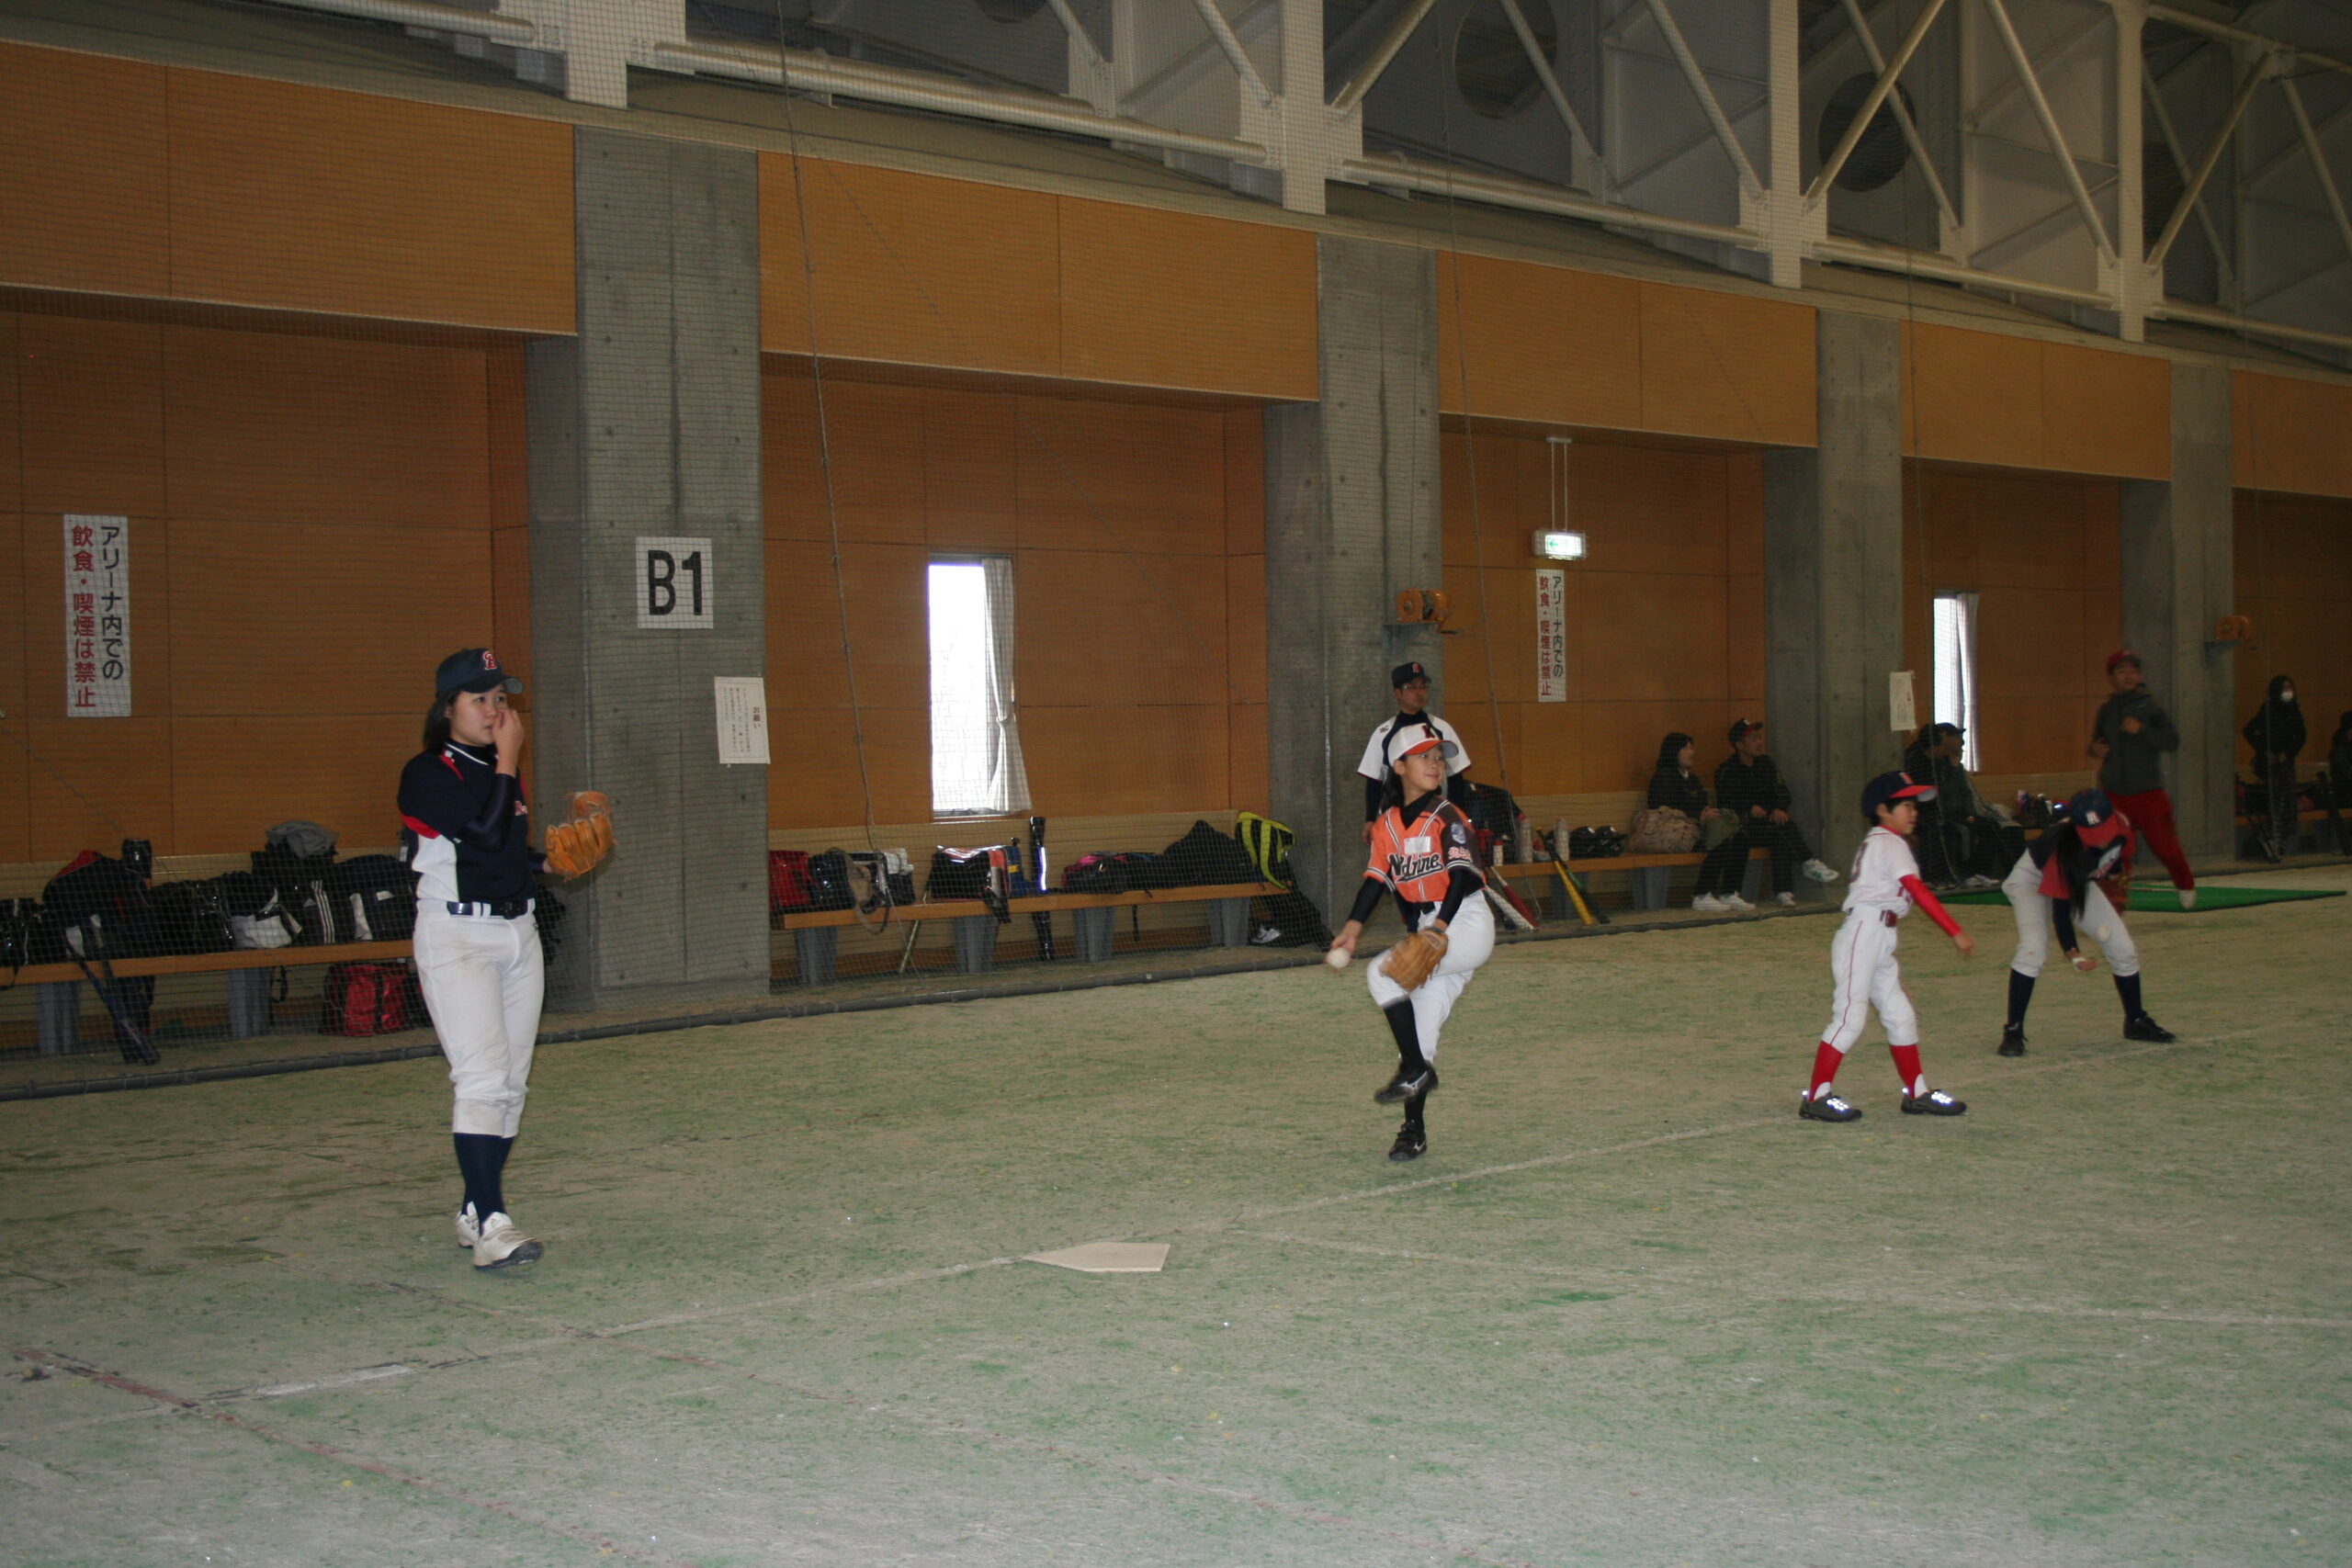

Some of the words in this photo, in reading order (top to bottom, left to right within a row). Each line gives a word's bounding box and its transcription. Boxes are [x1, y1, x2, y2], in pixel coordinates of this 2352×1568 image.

[72, 525, 96, 708] 飲食・喫煙は禁止
[100, 525, 124, 681] アリーナ内での
[648, 549, 703, 616] B1
[1540, 576, 1551, 696] 飲食・喫煙は禁止
[1553, 576, 1564, 678] アリーナ内での
